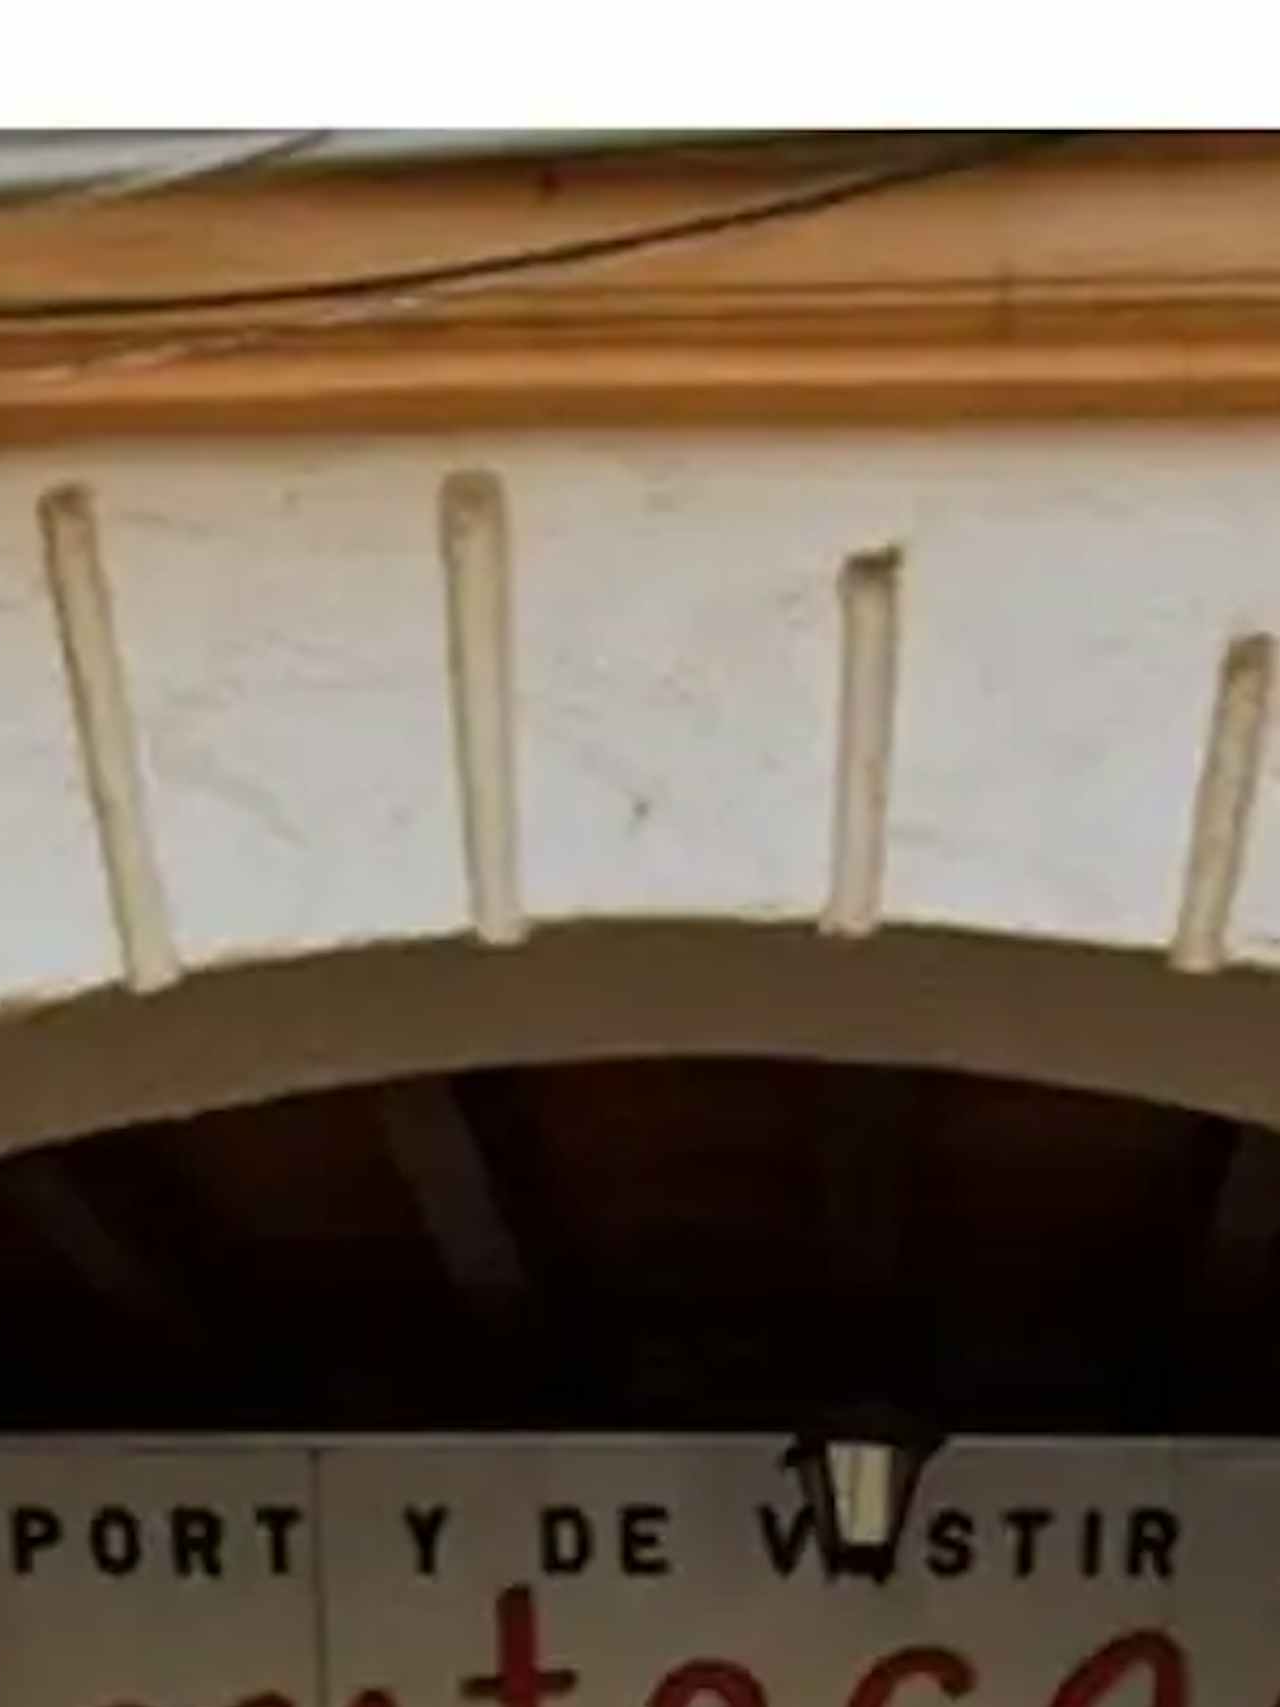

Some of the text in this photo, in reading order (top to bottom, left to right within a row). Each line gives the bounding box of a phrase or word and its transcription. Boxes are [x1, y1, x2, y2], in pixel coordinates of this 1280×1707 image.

[401, 1504, 451, 1575] Y
[539, 1504, 673, 1576] DE
[757, 1504, 1180, 1580] VSTIR
